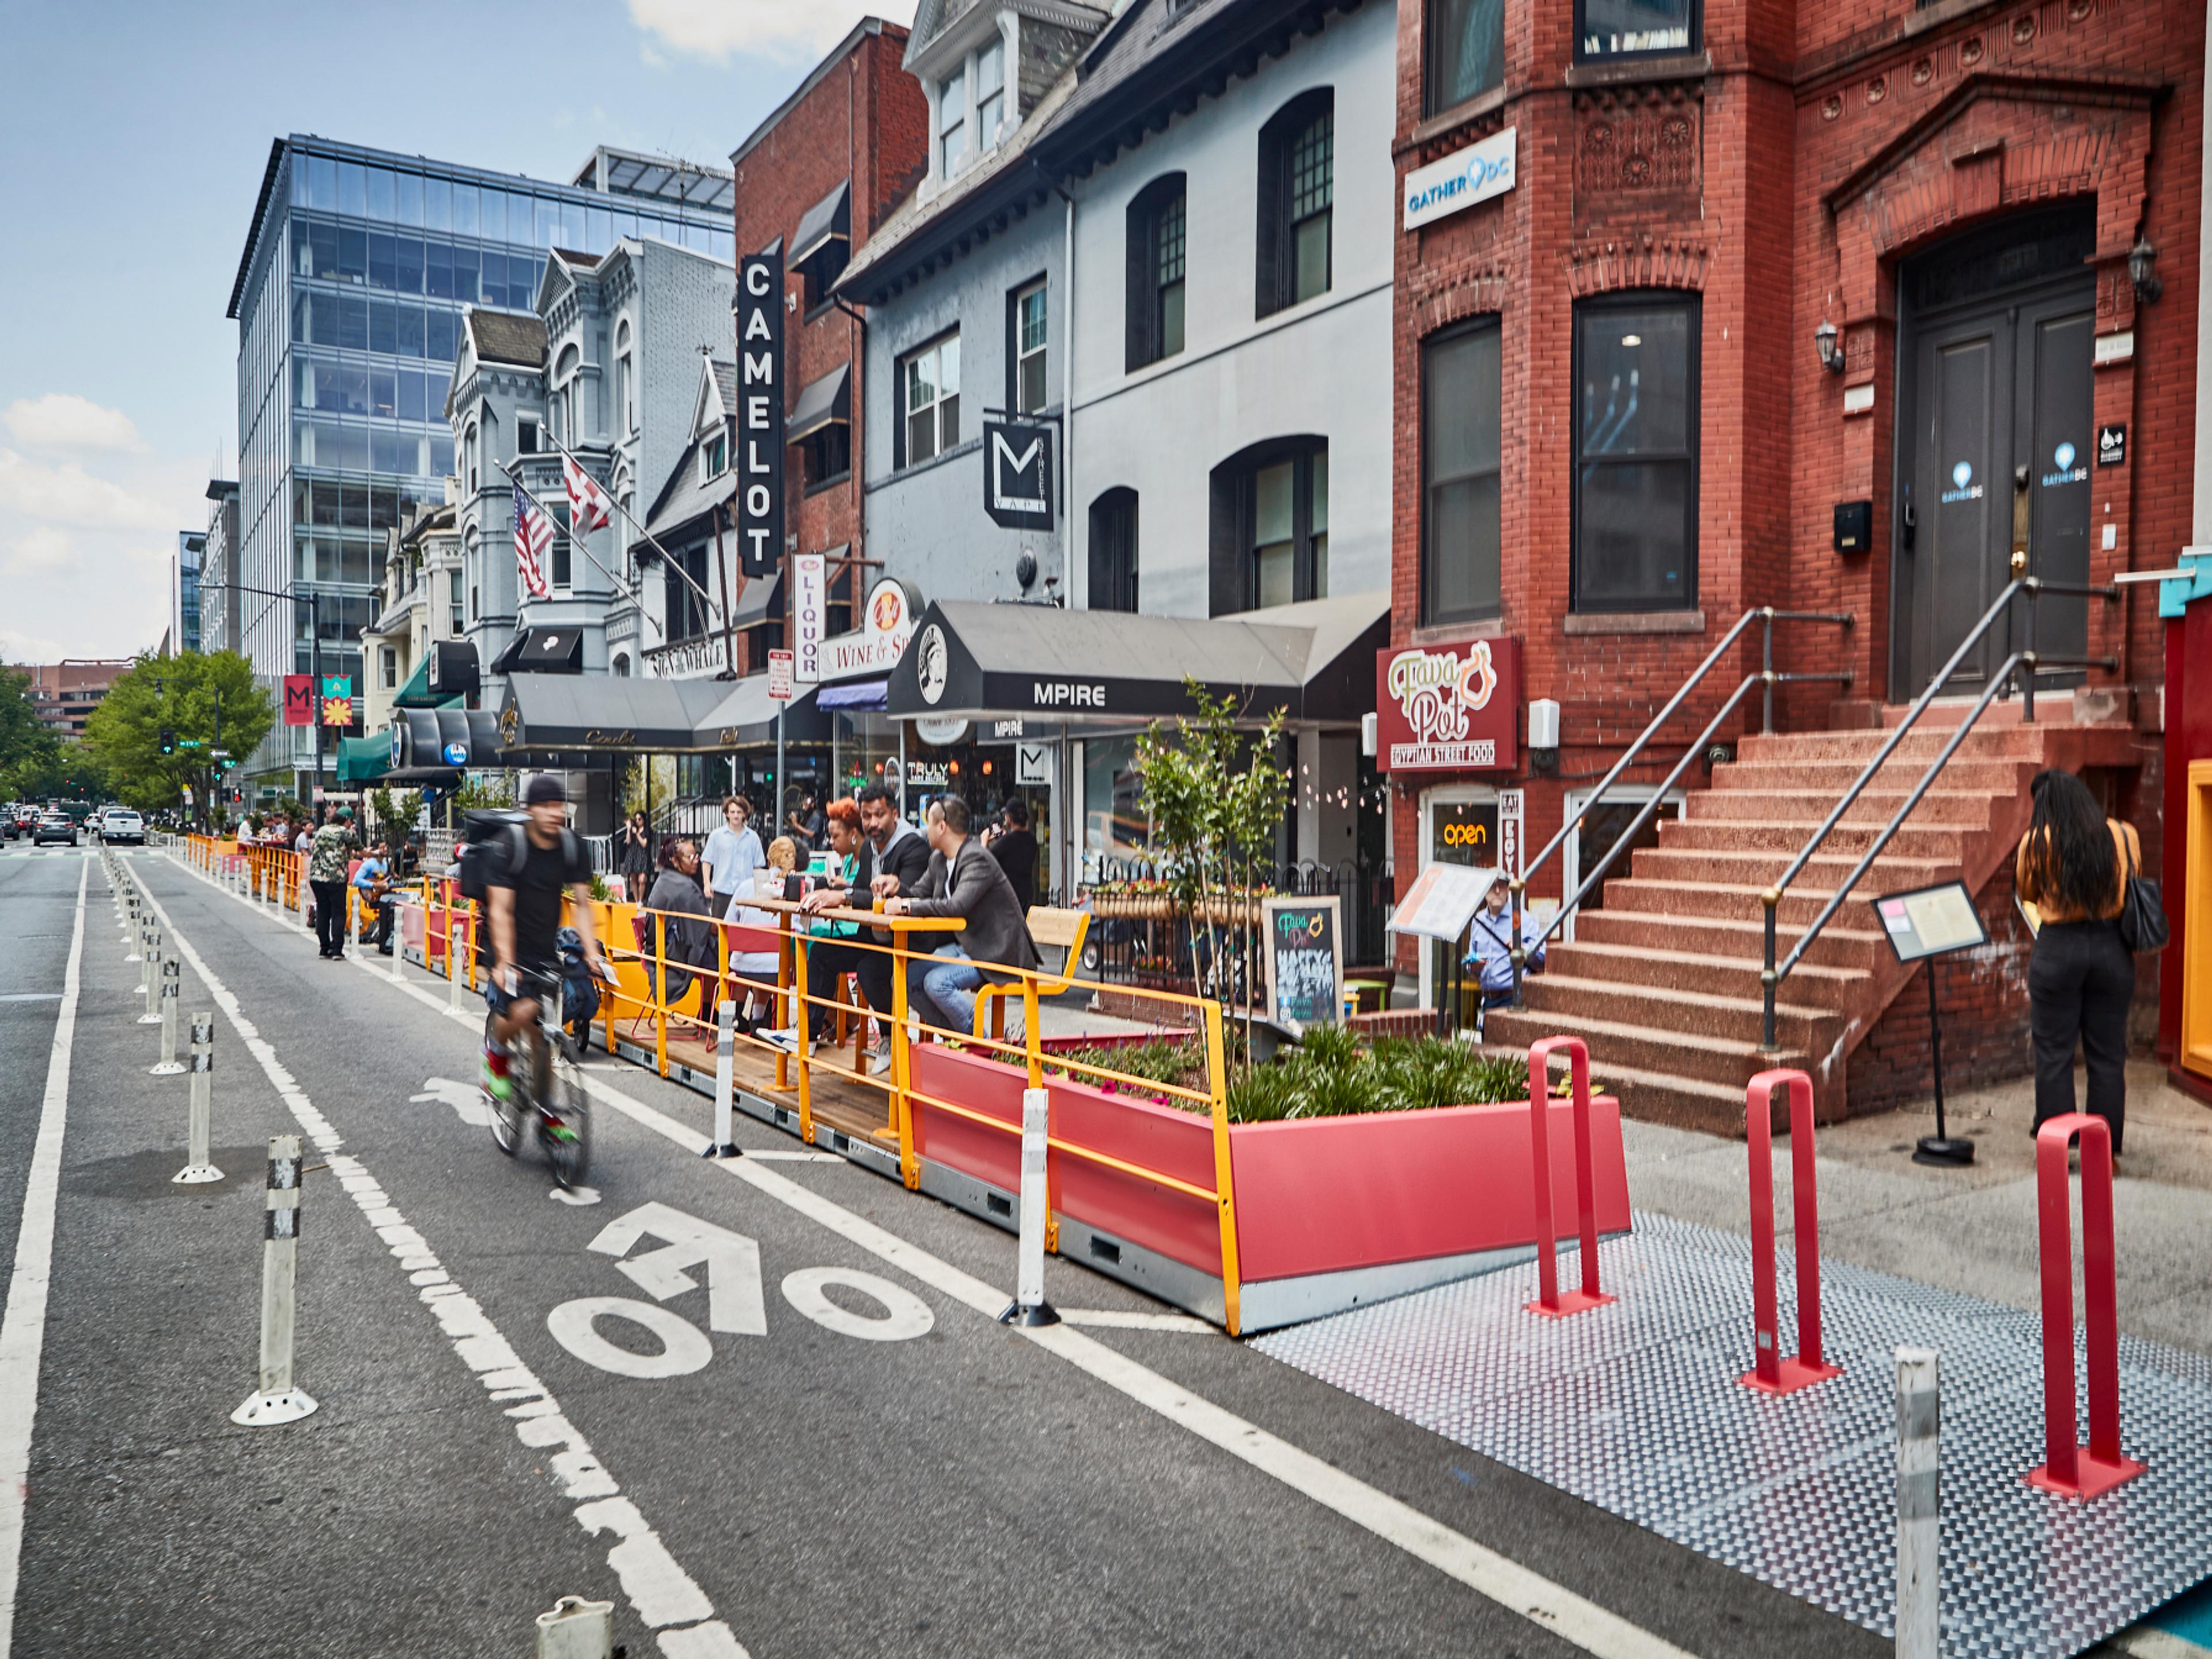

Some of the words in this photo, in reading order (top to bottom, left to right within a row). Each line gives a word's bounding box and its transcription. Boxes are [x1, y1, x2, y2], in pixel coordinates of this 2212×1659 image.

[1409, 175, 1467, 212] GATHER
[1487, 156, 1509, 181] DC
[744, 263, 772, 562] CAMELOT
[802, 576, 817, 672] LIQUOR
[1034, 682, 1105, 707] MPIRE
[1389, 653, 1460, 713] Fava
[287, 686, 309, 707] M
[995, 720, 1023, 738] MPIRE
[1411, 690, 1467, 746] Pot
[1392, 747, 1431, 765] EGYPTIAN
[1435, 745, 1465, 763] STREET
[1469, 744, 1495, 762] FOOD
[907, 762, 949, 778] TRULY
[1502, 795, 1518, 808] EAT
[1444, 823, 1486, 849] open
